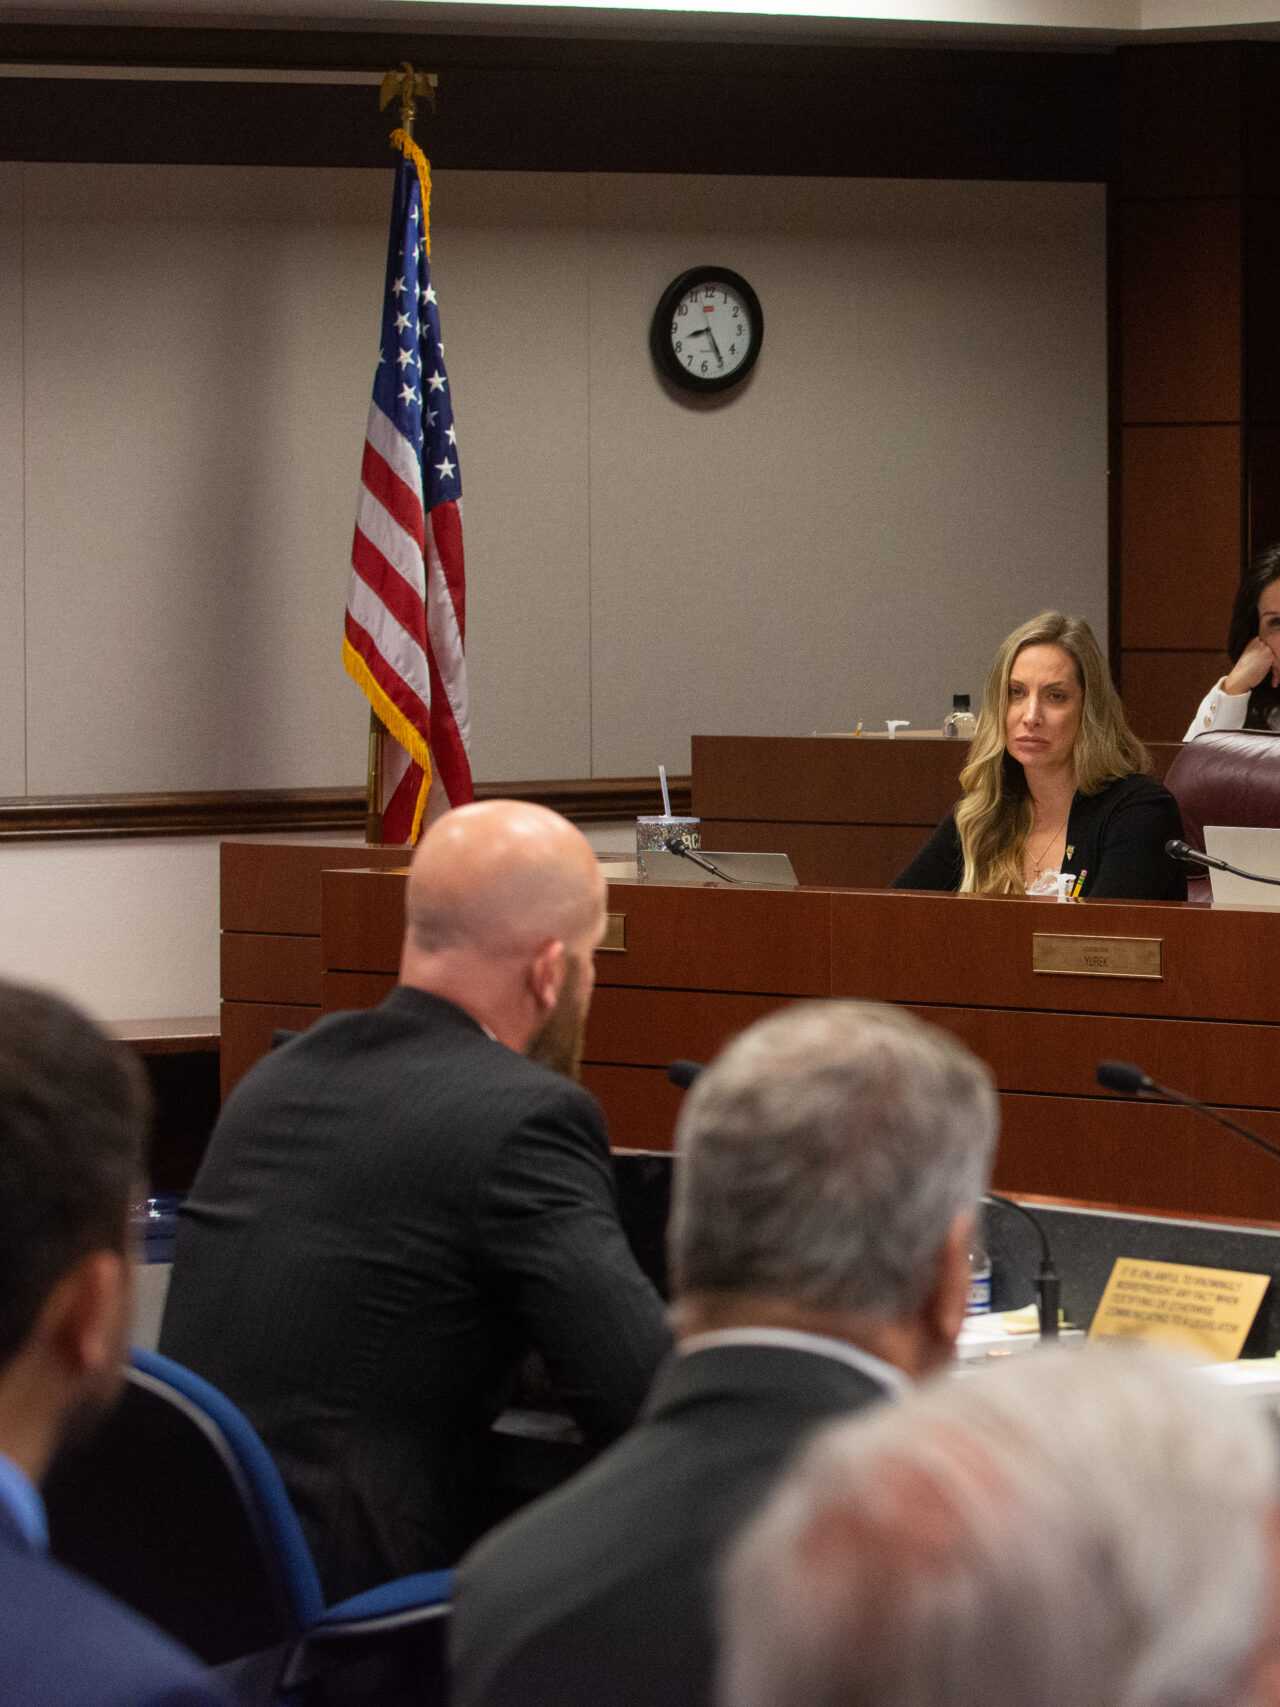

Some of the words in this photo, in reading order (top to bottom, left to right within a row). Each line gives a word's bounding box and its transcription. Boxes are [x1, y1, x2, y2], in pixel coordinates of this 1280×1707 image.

[689, 291, 698, 303] 11
[705, 286, 715, 298] 12
[723, 291, 728, 304] 1
[677, 304, 688, 316] 10
[732, 305, 739, 318] 2
[671, 323, 678, 334] 9
[736, 324, 743, 336] 3
[675, 341, 682, 353] 8
[729, 343, 736, 355] 4
[687, 355, 694, 367] 7
[701, 360, 708, 373] 6
[1084, 955, 1109, 968] YUREK
